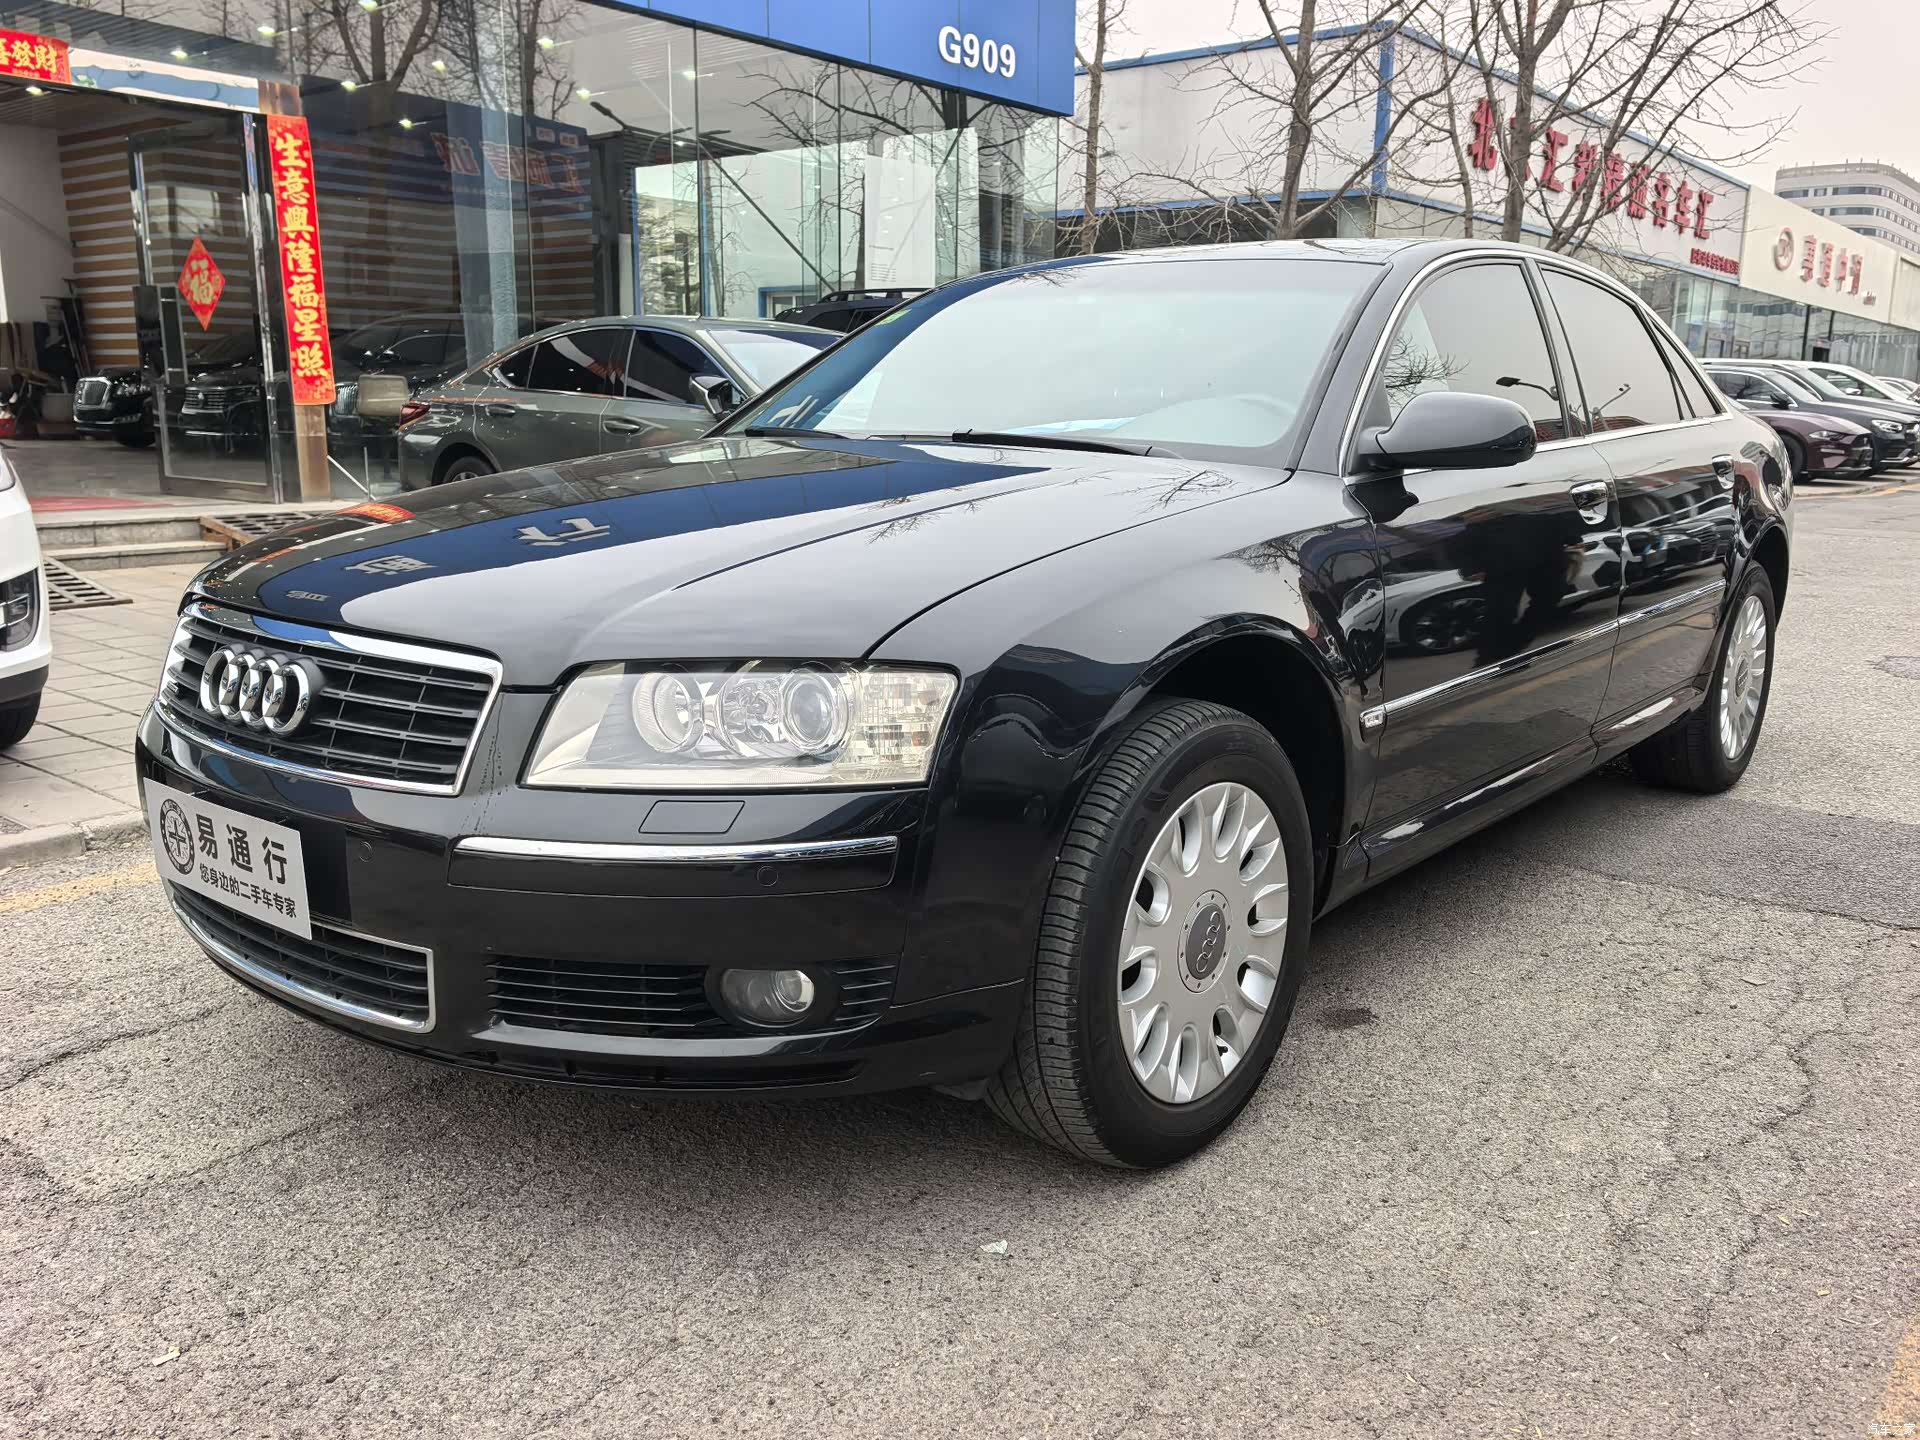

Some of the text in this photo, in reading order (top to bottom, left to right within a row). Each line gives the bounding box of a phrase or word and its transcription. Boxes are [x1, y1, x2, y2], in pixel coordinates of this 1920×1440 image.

[938, 25, 1016, 78] G909
[188, 258, 213, 305] 福
[274, 132, 328, 377] 生意興隆福星照
[196, 813, 288, 885] 易通行
[199, 862, 297, 919] 您身边的二手车专家
